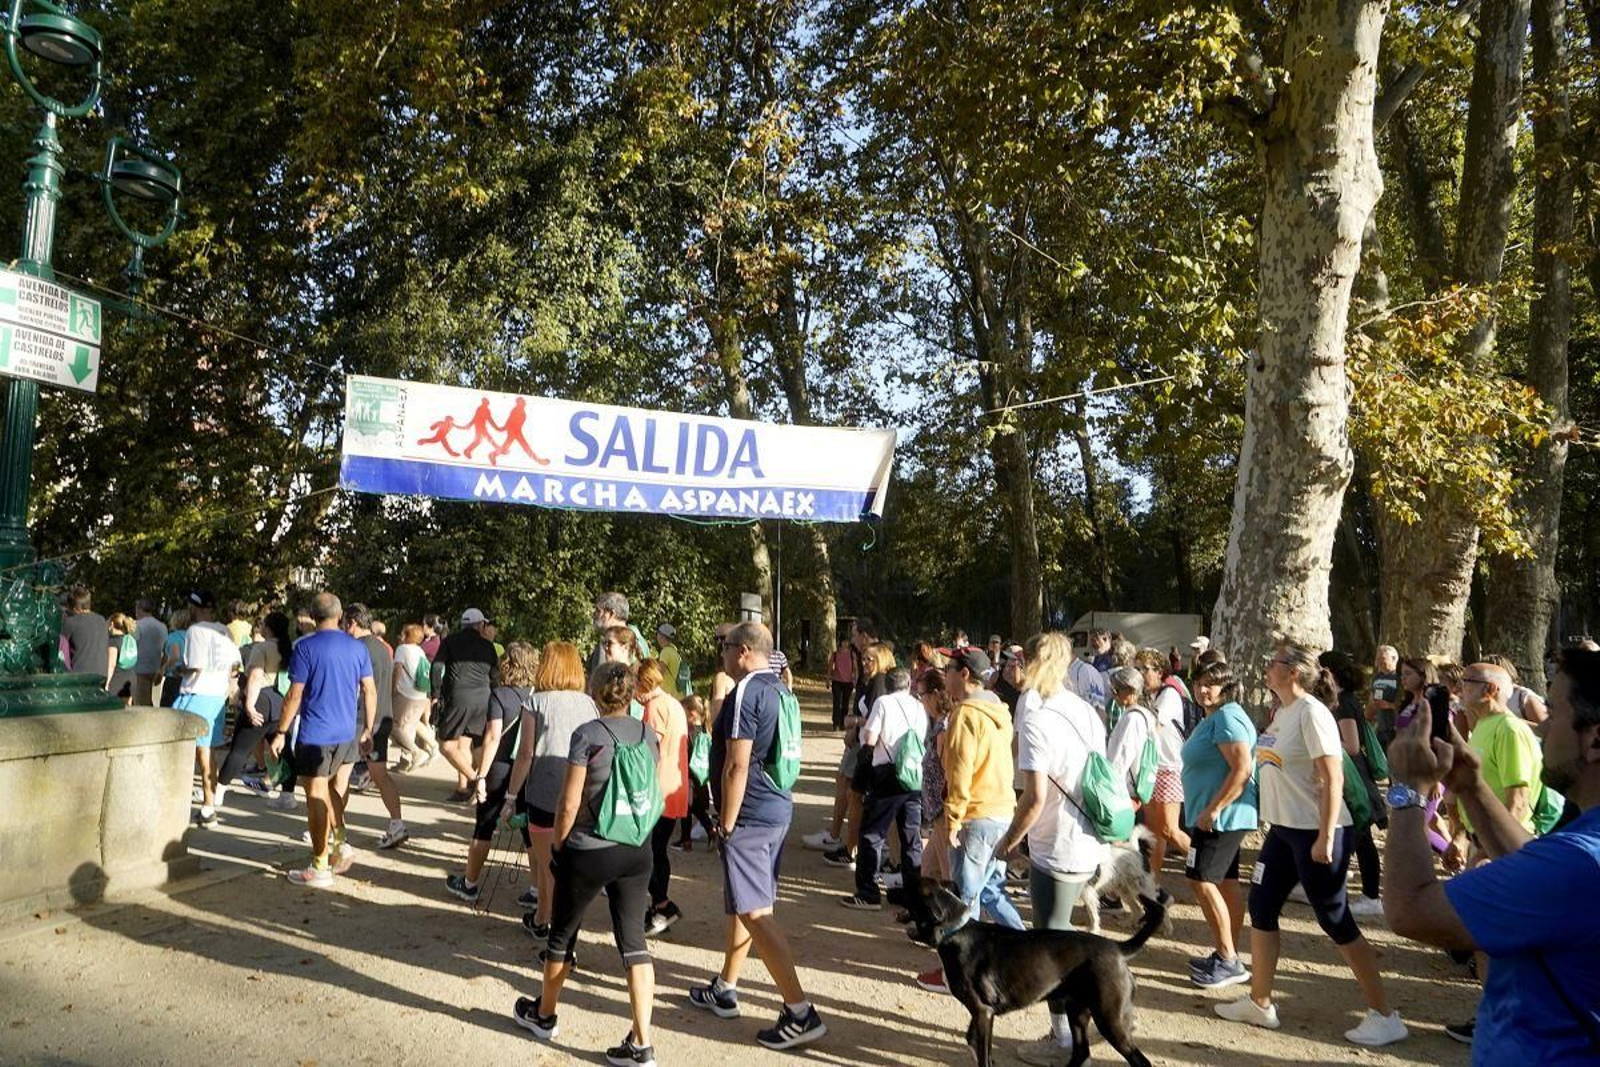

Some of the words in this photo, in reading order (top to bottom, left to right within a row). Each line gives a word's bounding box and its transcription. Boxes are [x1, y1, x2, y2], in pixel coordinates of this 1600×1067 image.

[19, 278, 59, 299] AVENIDA
[60, 290, 69, 301] DE
[19, 290, 69, 313] CASTRELOS
[15, 328, 54, 346] AVENIDA
[55, 339, 65, 350] DE
[14, 341, 64, 361] CASTRELOS
[564, 410, 765, 478] SALIDA
[473, 472, 648, 509] MARCHA
[660, 488, 815, 516] ASPANAEX
